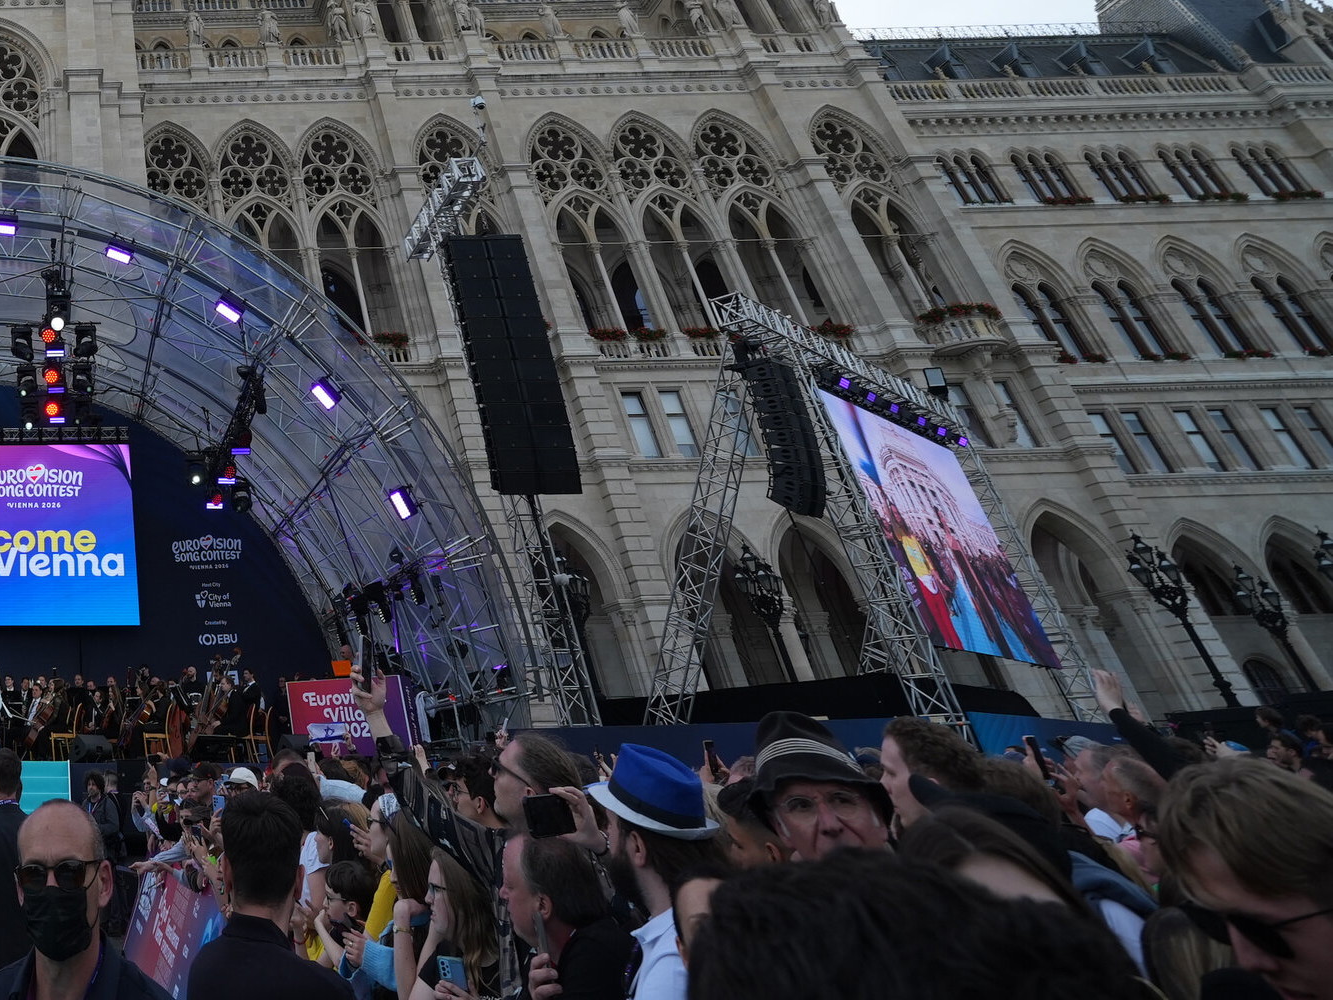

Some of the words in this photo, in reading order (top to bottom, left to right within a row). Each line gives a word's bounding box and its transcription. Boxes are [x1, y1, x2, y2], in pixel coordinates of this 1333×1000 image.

[25, 484, 81, 497] CONTEST
[174, 551, 200, 562] SONG
[200, 550, 241, 561] CONTEST
[208, 593, 221, 601] City
[217, 633, 238, 644] EBU
[302, 689, 355, 706] Eurovi
[323, 706, 366, 722] Villa
[345, 722, 371, 738] 02
